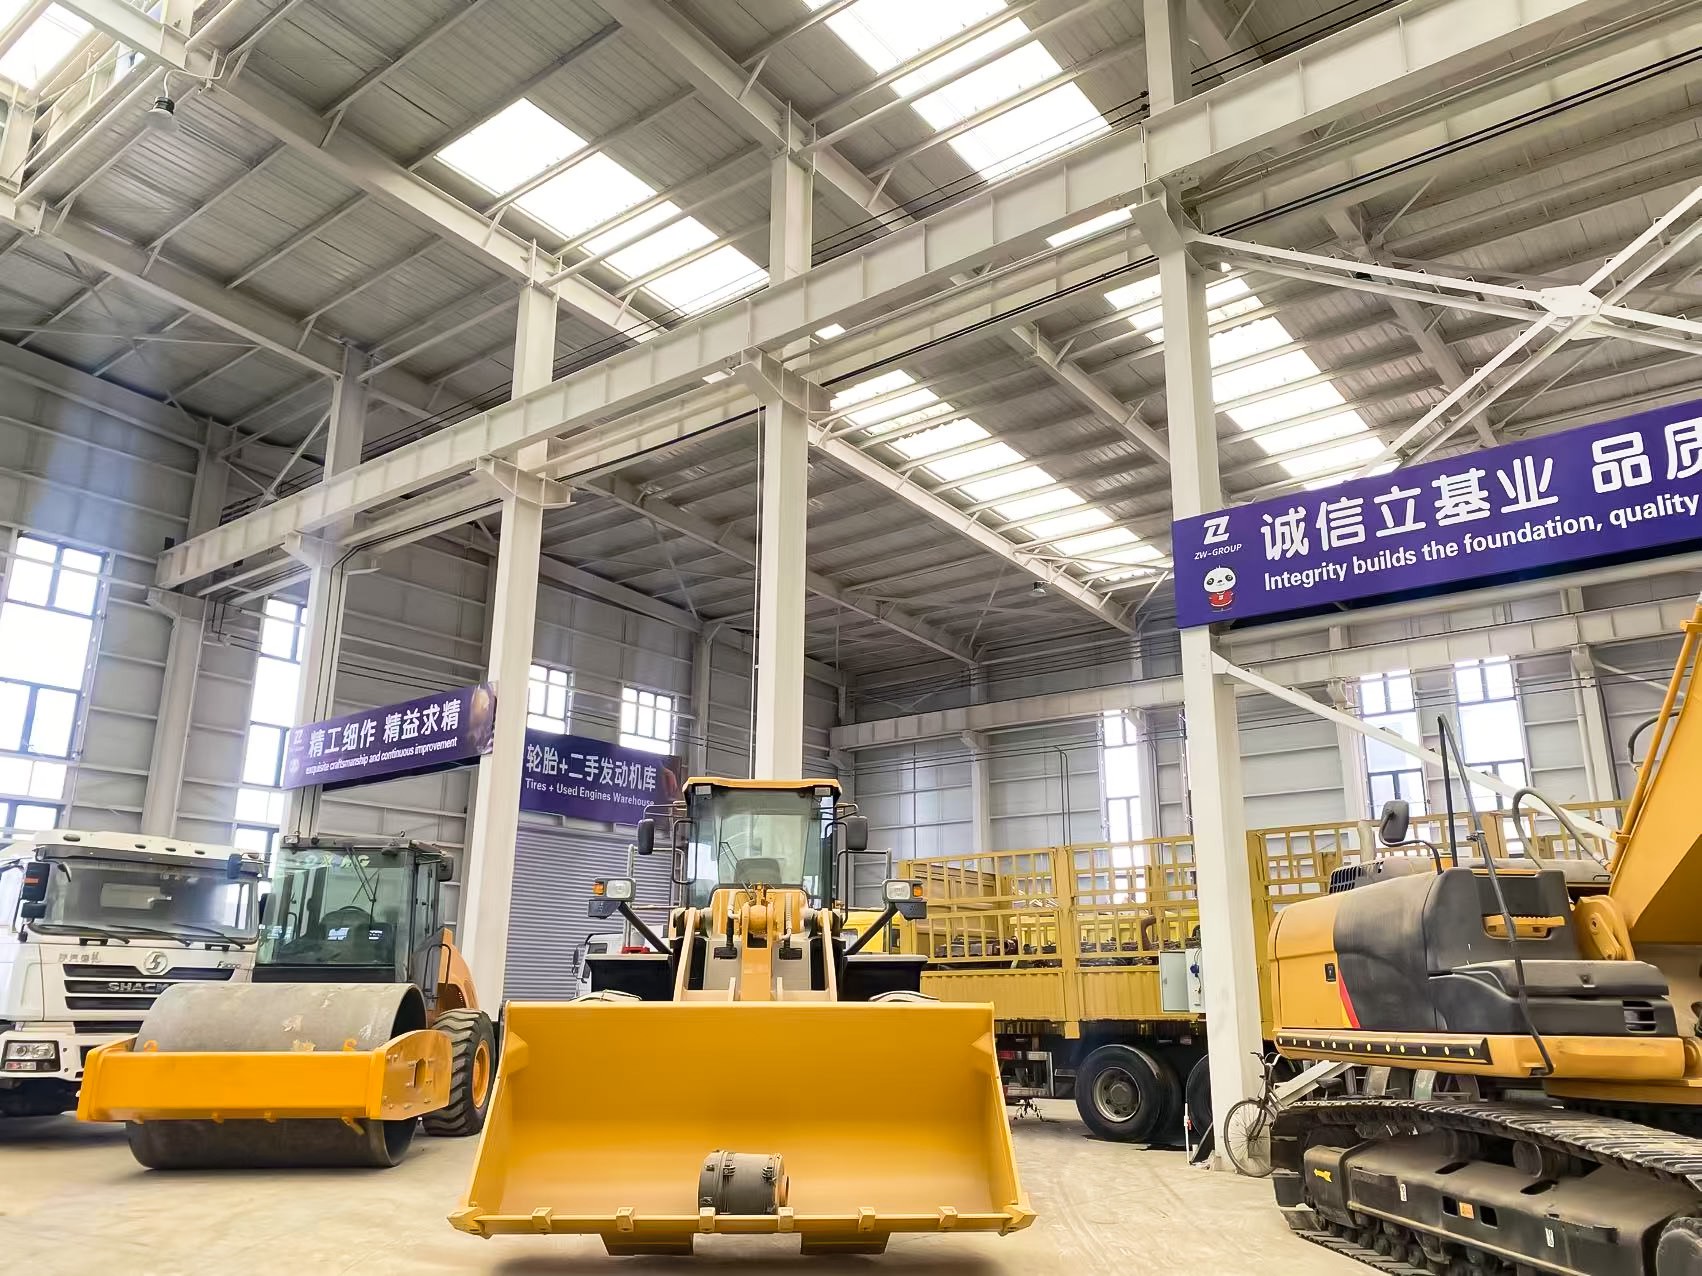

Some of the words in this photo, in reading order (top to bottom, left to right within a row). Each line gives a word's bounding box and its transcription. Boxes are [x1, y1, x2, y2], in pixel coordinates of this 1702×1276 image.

[1260, 456, 1559, 561] 诚信立基业
[1193, 543, 1242, 560] ZW-GROUP
[1264, 561, 1348, 591] Integrity
[1353, 546, 1417, 575] builds
[1421, 540, 1459, 561] the
[1463, 515, 1603, 554] foundation,
[1609, 493, 1700, 528] quality
[308, 718, 377, 758] 精工细作
[382, 698, 461, 744] 精益求精
[330, 756, 368, 772] craftsmanship
[369, 751, 380, 763] and
[380, 745, 414, 761] continuous
[414, 737, 458, 756] improvement
[526, 743, 657, 792] 轮胎+二手发动机库
[525, 777, 547, 792] Tires
[556, 782, 578, 796] Used
[579, 786, 611, 801] Engines
[613, 791, 655, 807] Warehouse
